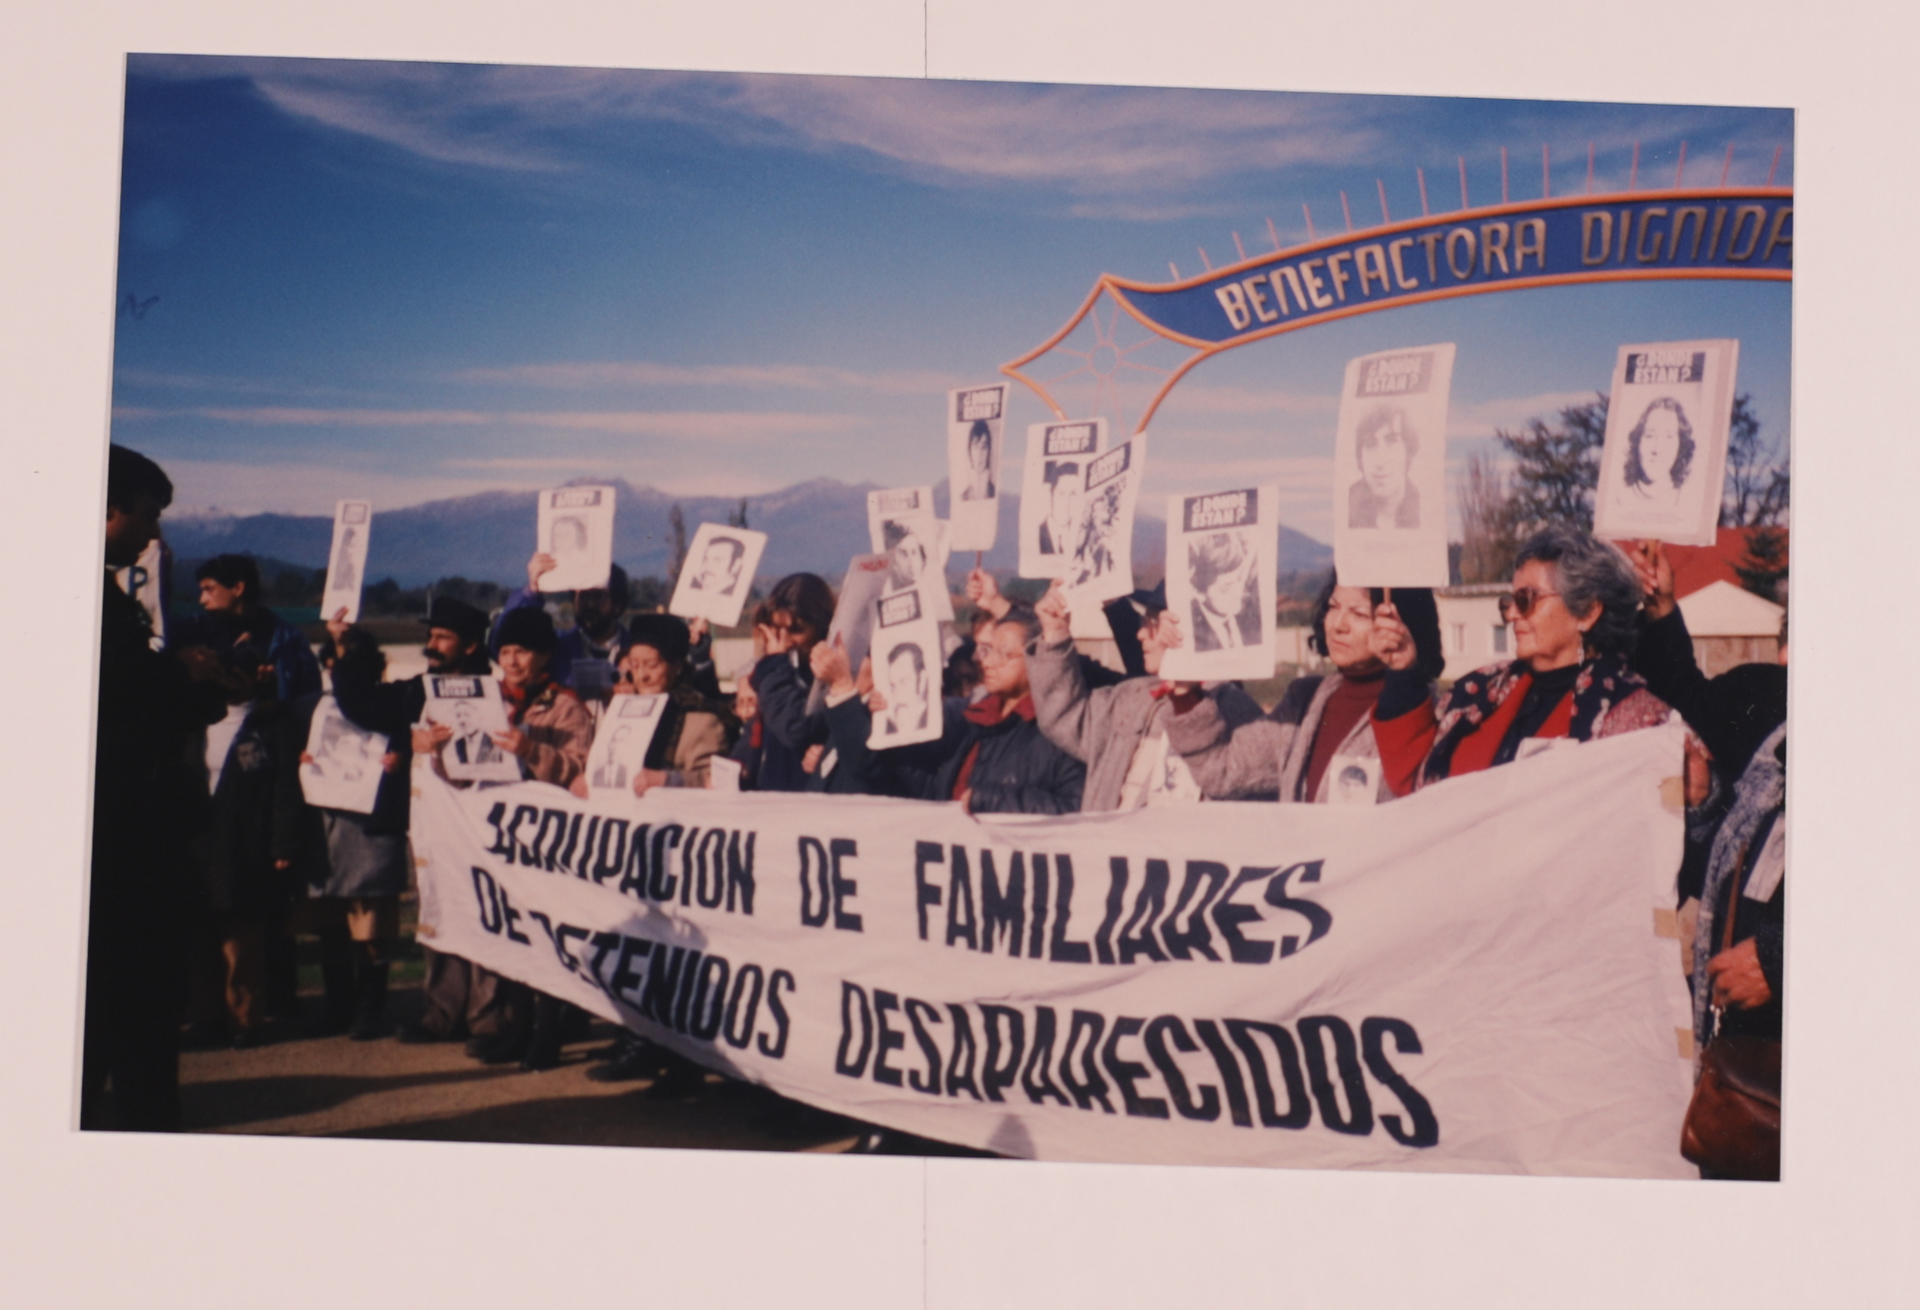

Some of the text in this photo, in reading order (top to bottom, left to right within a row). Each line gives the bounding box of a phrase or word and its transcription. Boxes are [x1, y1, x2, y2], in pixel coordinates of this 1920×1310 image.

[1213, 217, 1547, 331] BENEFACTORA
[799, 835, 864, 933] DE
[915, 840, 1333, 965] FAMILIARES
[835, 979, 1439, 1149] DESAPARECIDOS
